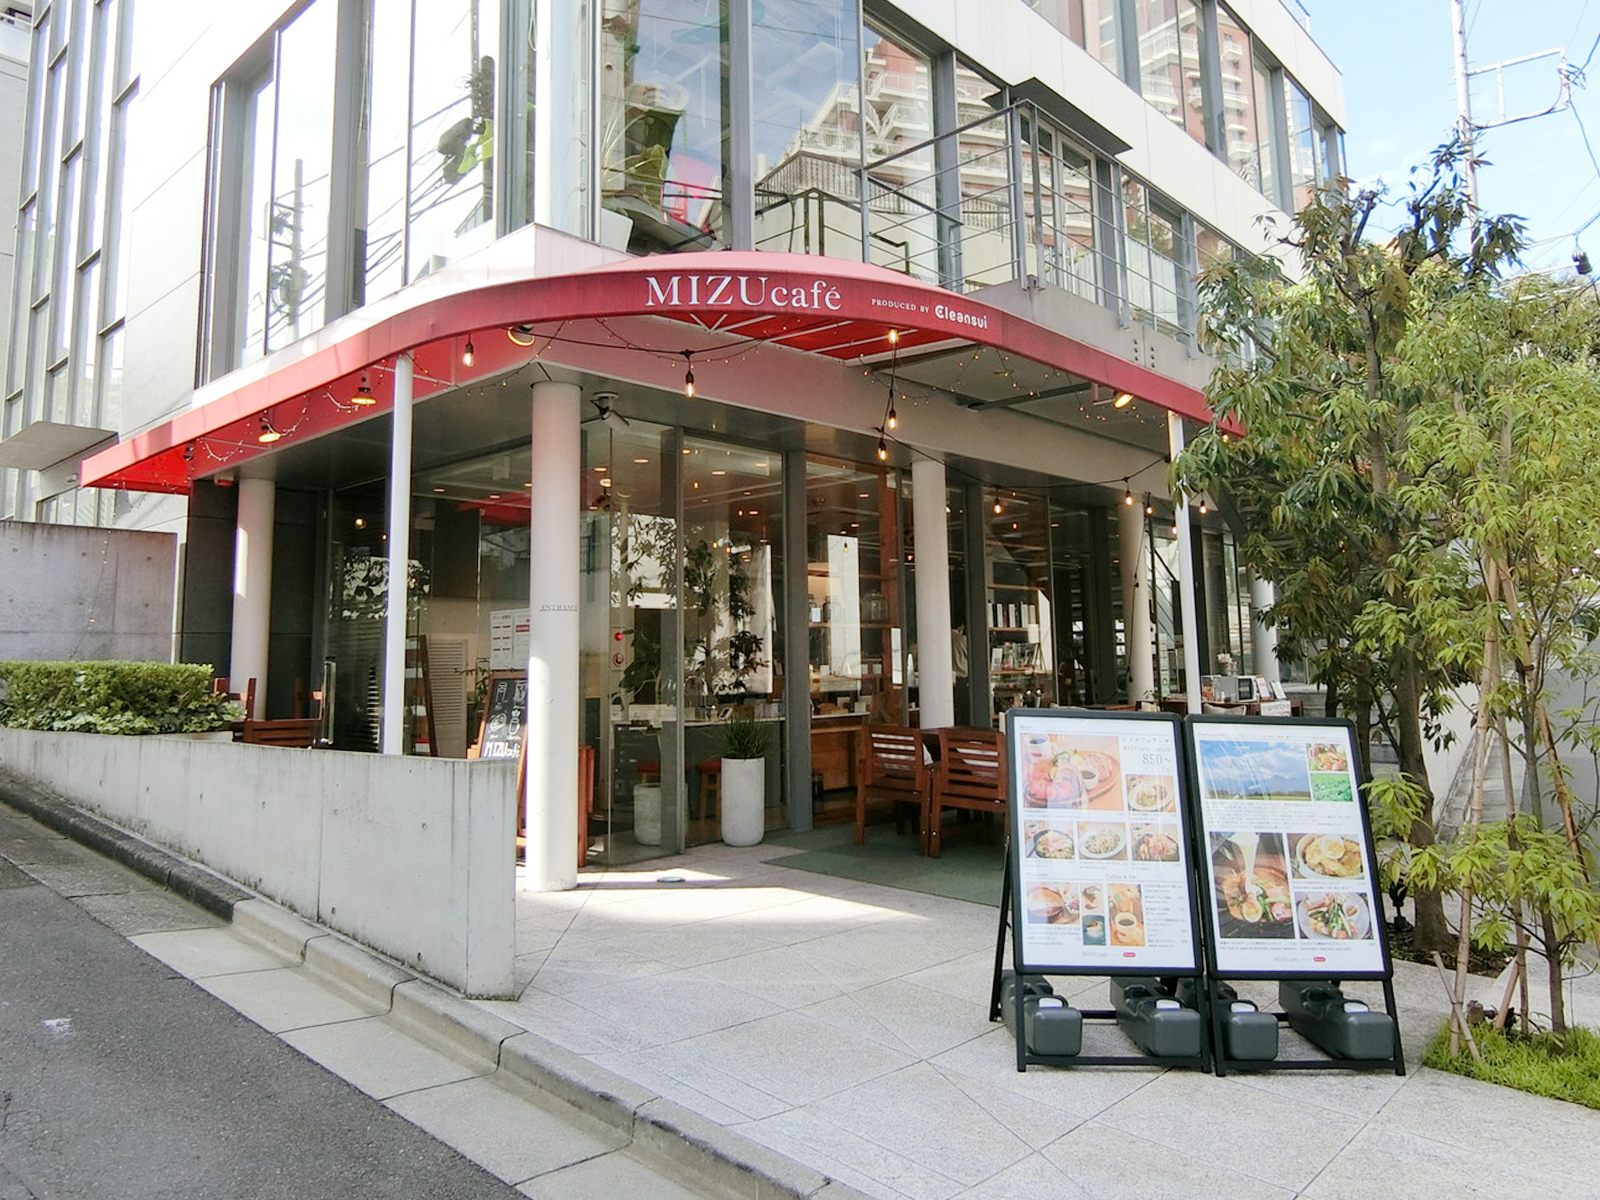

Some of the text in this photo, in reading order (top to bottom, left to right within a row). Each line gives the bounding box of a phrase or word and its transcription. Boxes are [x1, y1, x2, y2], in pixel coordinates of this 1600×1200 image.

[871, 298, 988, 329] PRODUCED BY Cleansui
